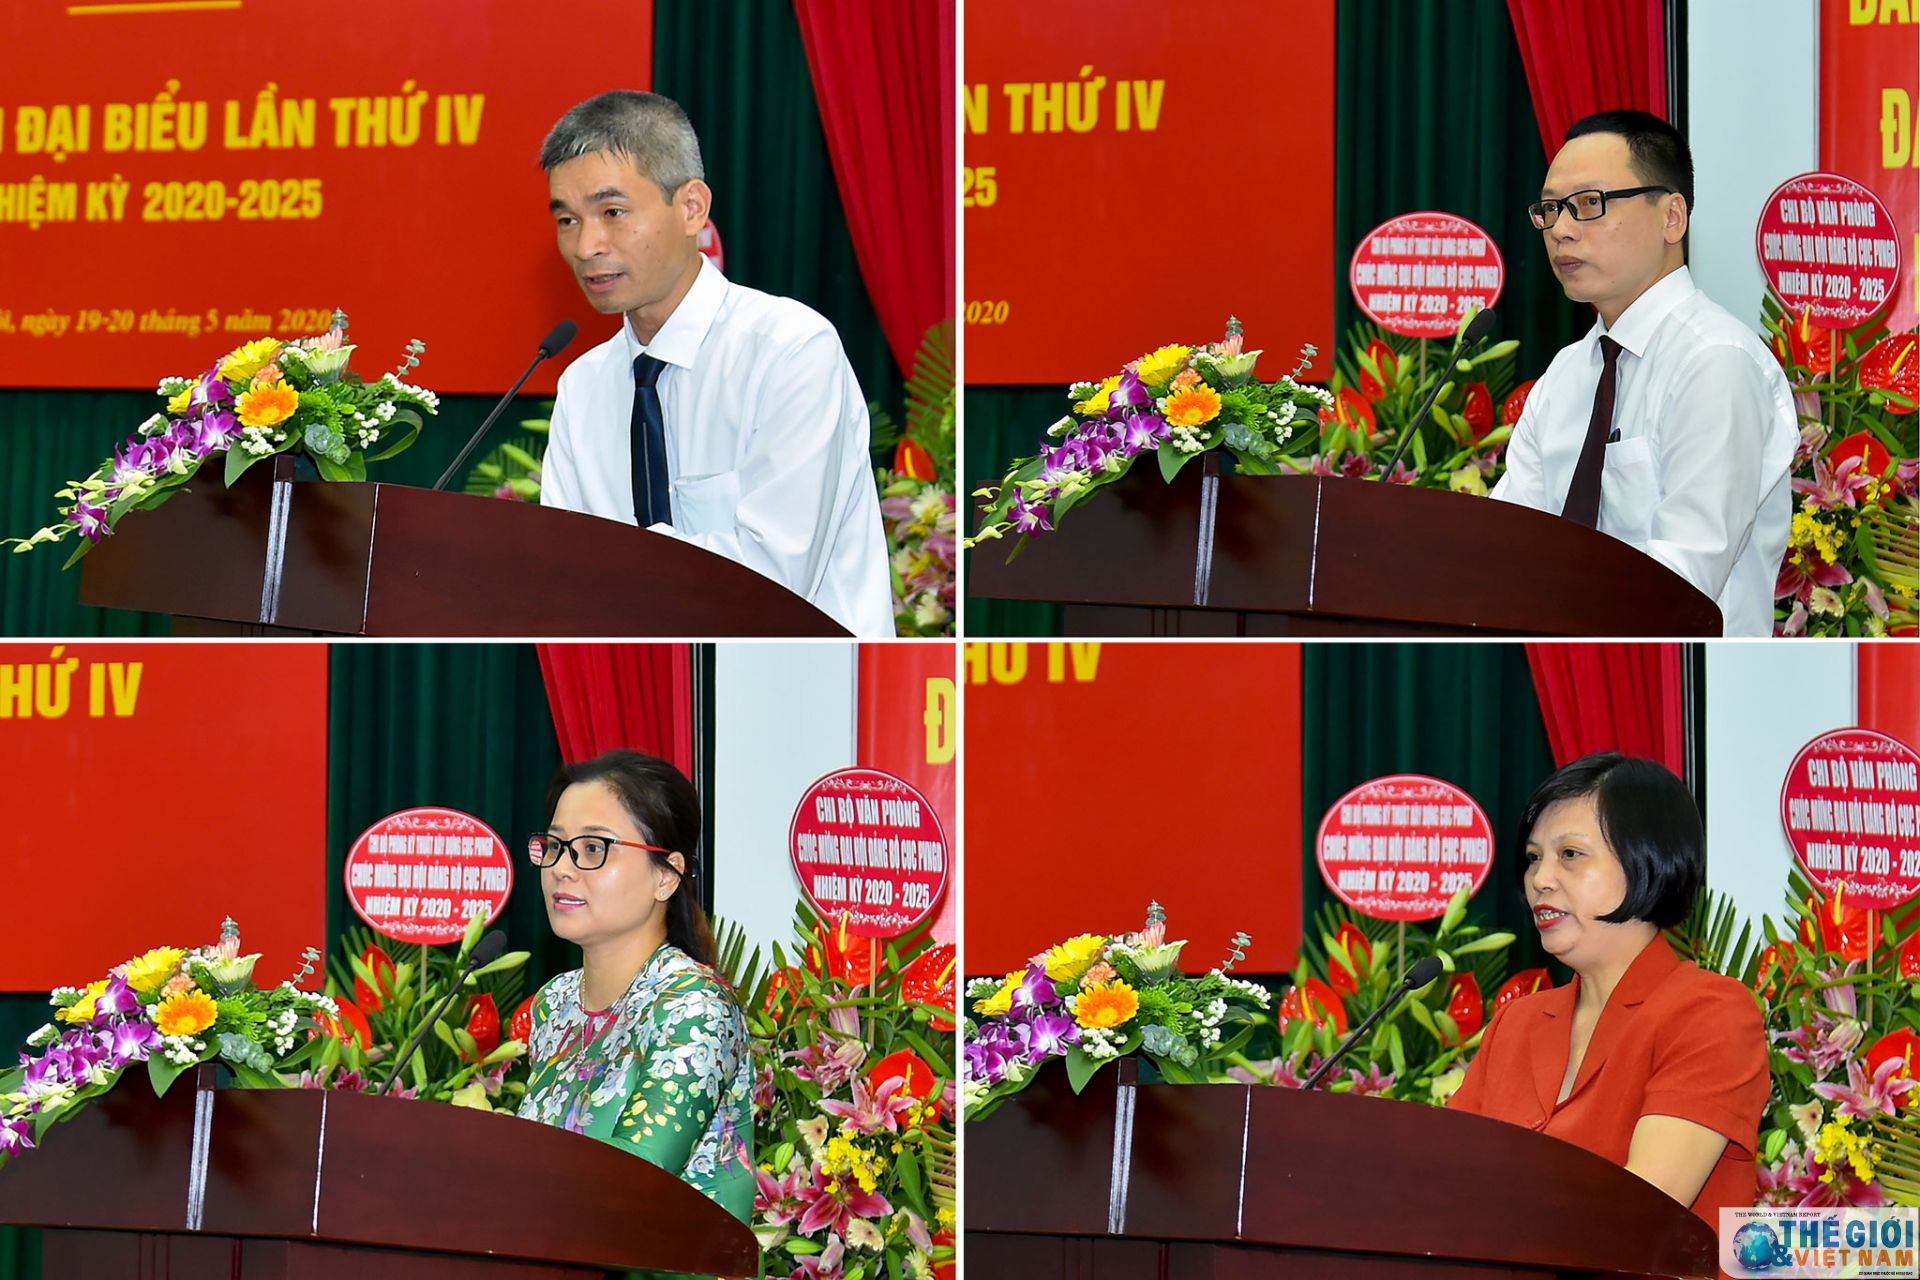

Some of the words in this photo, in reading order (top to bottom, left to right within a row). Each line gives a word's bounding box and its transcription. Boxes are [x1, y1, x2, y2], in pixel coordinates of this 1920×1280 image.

[1003, 64, 1106, 134] THỨ
[1115, 79, 1165, 132] IV
[15, 104, 91, 163] ĐẠI
[103, 78, 208, 153] BIỂU
[224, 81, 317, 150] LẦN
[329, 79, 429, 148] THỨ
[435, 94, 485, 146] IV
[142, 178, 323, 222] 2020-2025
[1780, 198, 1799, 223] CHI
[1800, 196, 1815, 229] BỘ
[1817, 197, 1838, 225] VĂN
[1840, 198, 1875, 227] PHÒNG
[1778, 269, 1808, 299] NHIỆM
[1826, 275, 1851, 299] 2020
[1859, 277, 1884, 302] 2025
[20, 307, 71, 338] ngày
[76, 308, 135, 333] 19-20
[139, 307, 201, 338] tháng
[204, 308, 219, 333] 5
[277, 307, 332, 333] 2020
[964, 300, 1009, 325] 020
[1419, 295, 1448, 314] 2020
[1048, 642, 1102, 683] IV
[90, 662, 143, 718] IV
[1807, 758, 1830, 787] CHI
[1831, 755, 1848, 793] BỘ
[1850, 756, 1875, 789] VĂN
[1877, 757, 1917, 791] PHÒNG
[816, 796, 836, 822] CHI
[838, 793, 854, 829] BỘ
[856, 794, 879, 825] VĂN
[881, 796, 920, 828] PHÒNG
[1807, 839, 1841, 875] NHIỆM
[1861, 846, 1890, 875] 2020
[814, 872, 846, 906] NHIỆM
[865, 878, 892, 906] 2020
[902, 882, 930, 909] 2025
[1396, 871, 1429, 893] 2020
[420, 897, 450, 918] 2020
